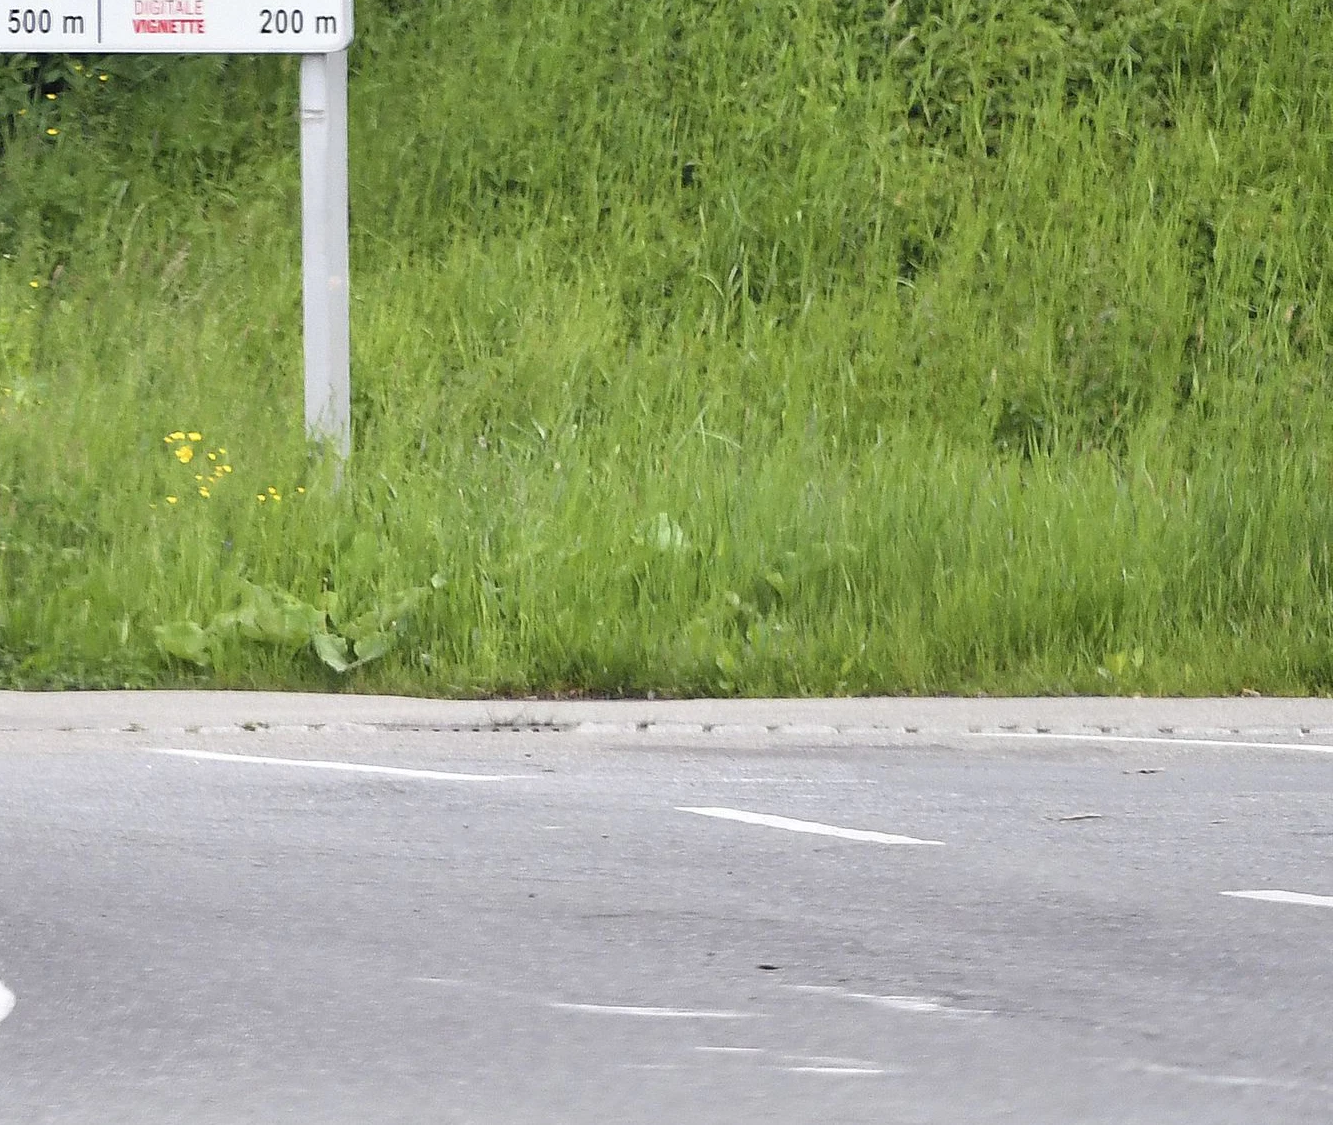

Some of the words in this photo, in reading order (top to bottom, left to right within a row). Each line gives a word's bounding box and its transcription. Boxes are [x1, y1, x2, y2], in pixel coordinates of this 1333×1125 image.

[134, 0, 204, 15] DIGITALE
[7, 9, 52, 34] 500
[62, 15, 85, 34] m
[132, 19, 205, 34] VIGNETTE
[259, 9, 304, 34] 200
[315, 15, 337, 34] m
